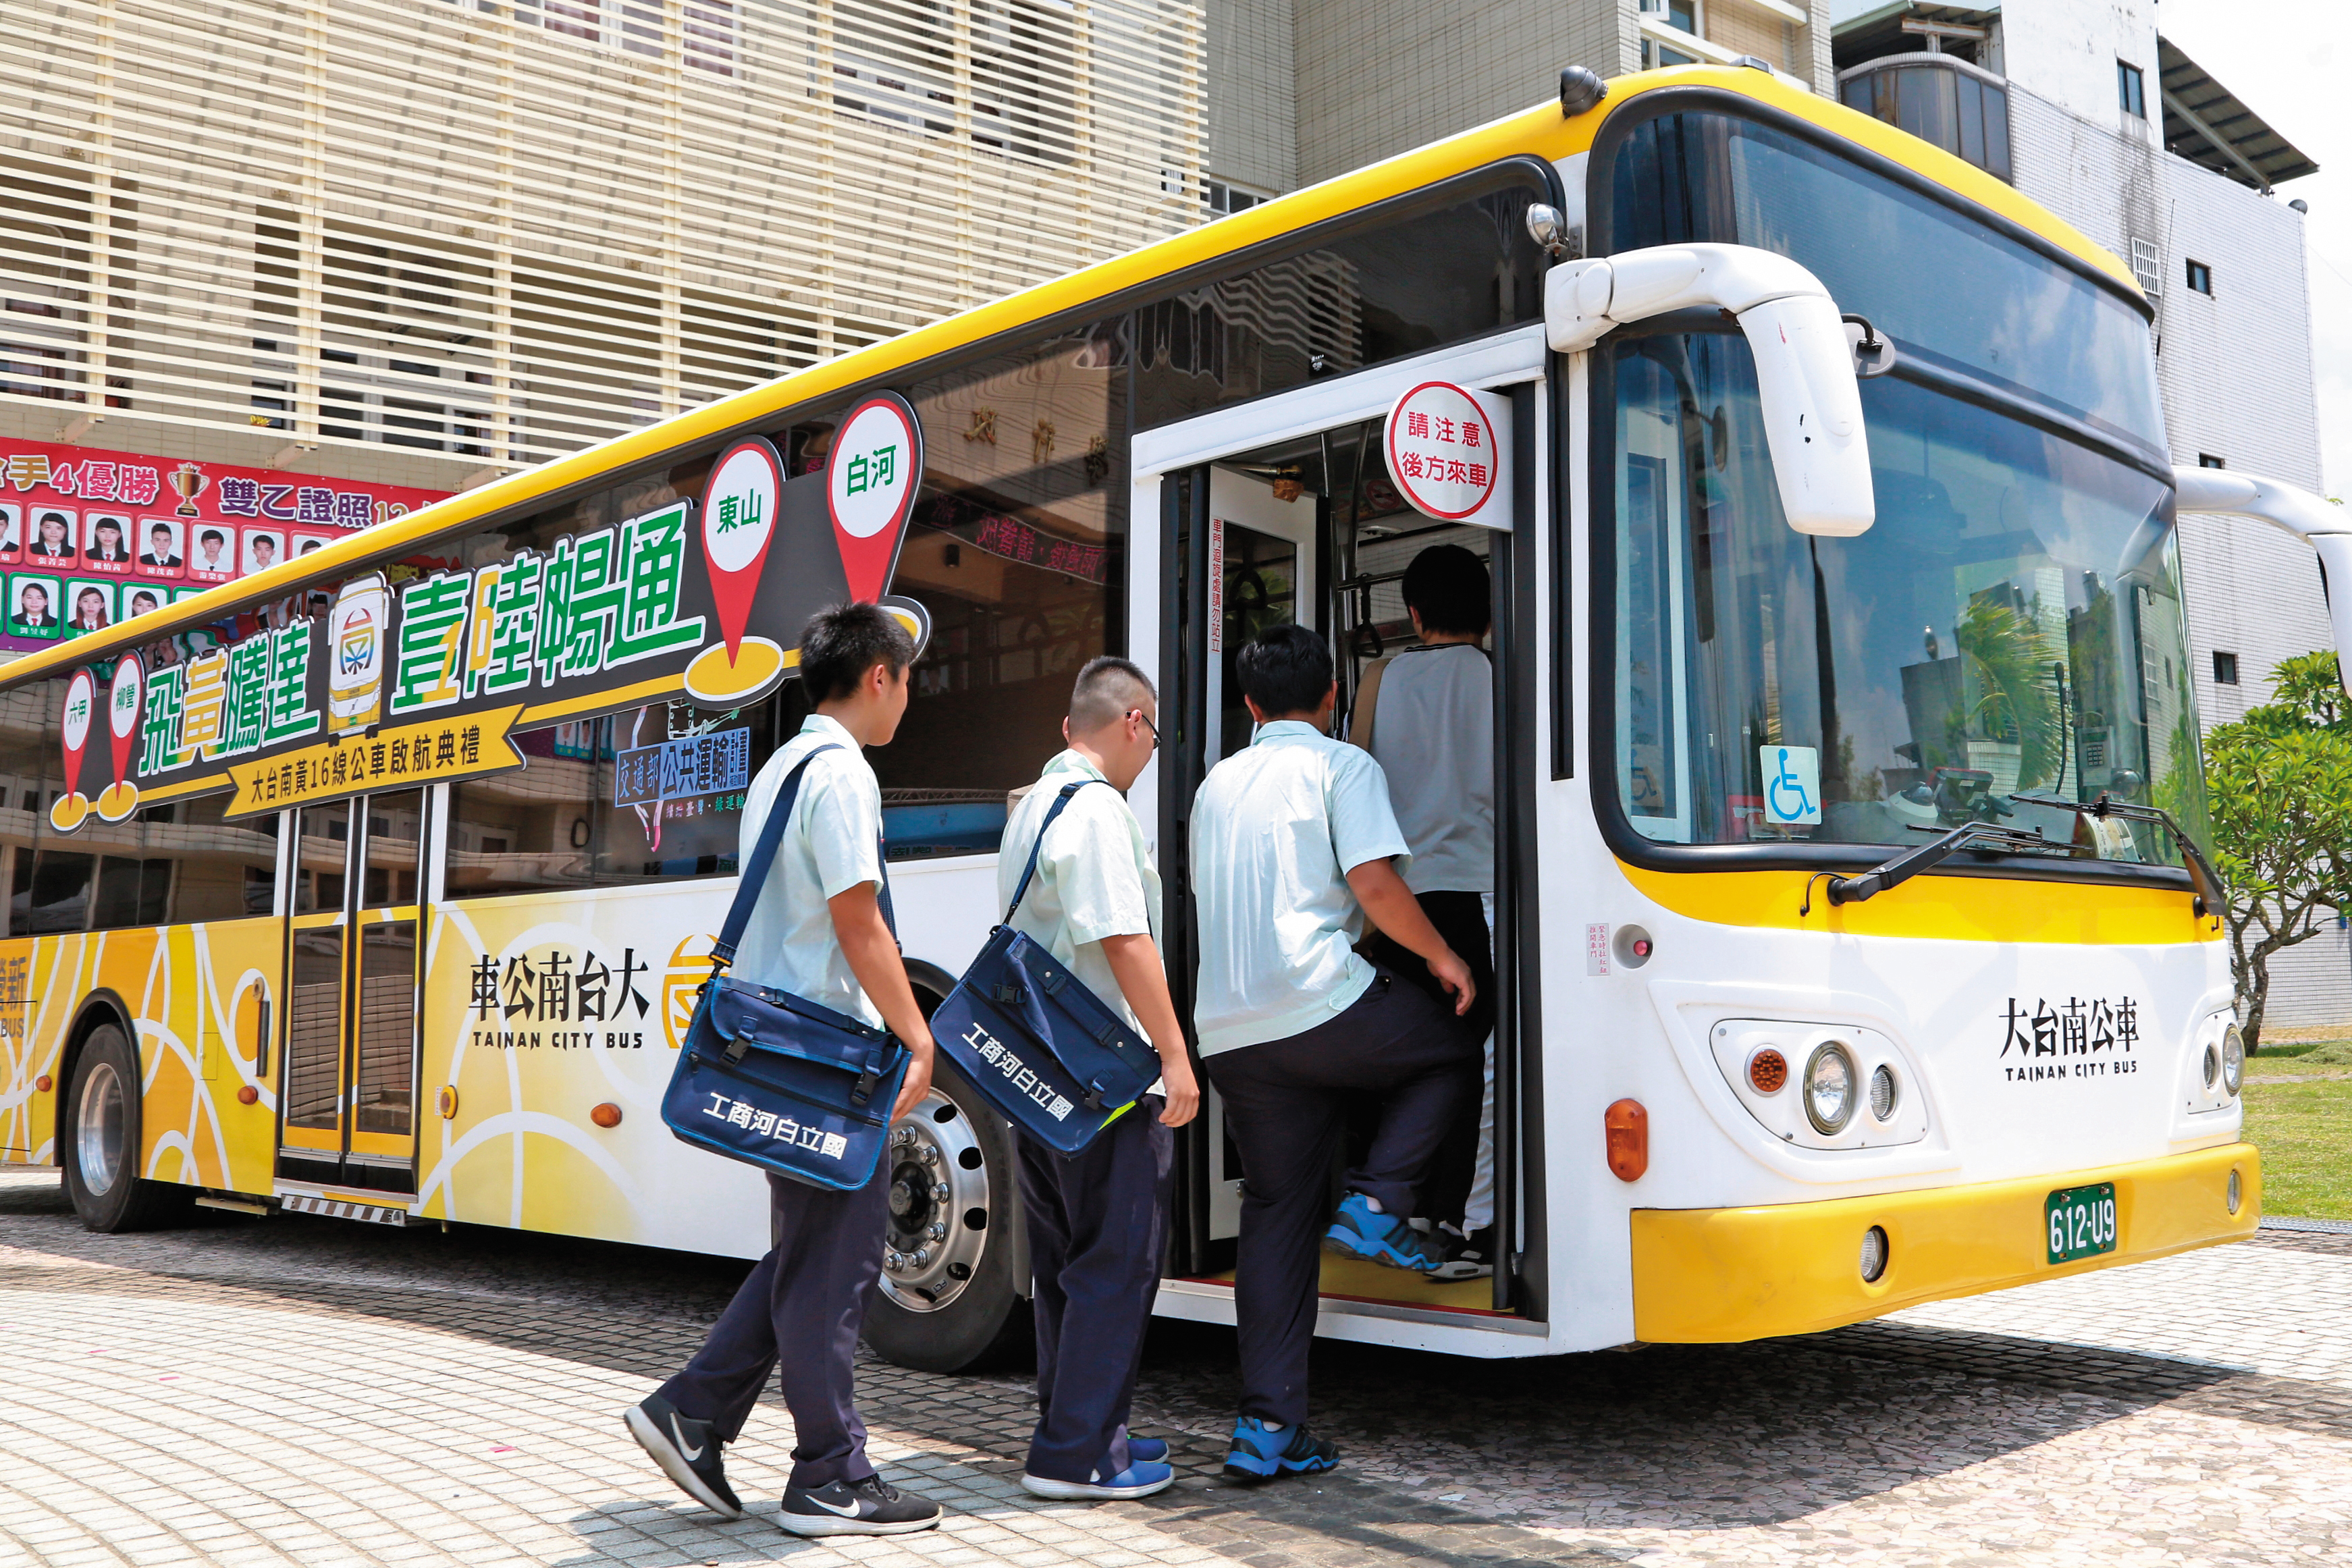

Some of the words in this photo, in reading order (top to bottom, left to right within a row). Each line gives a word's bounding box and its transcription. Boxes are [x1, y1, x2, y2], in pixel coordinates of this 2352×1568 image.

[1408, 411, 1480, 448] 請注意
[0, 455, 159, 506] 手4優勝
[847, 444, 897, 497] 白河
[1402, 451, 1488, 488] 後方來車
[717, 487, 762, 535] 東山
[68, 699, 86, 726] 六甲
[115, 682, 135, 713] 柳營
[138, 615, 320, 778] 飛黃騰達
[619, 753, 660, 799] 交通部
[1, 1018, 24, 1037] BUS
[474, 1031, 540, 1051] TAINAN
[552, 1032, 594, 1052] CITY
[607, 1032, 643, 1049] BUS
[1999, 996, 2139, 1059] 大台南公車
[2006, 1065, 2066, 1082] TAINAN
[2075, 1062, 2106, 1079] CITY
[2114, 1060, 2137, 1074] BUS
[2050, 1199, 2115, 1253] 612-U9
